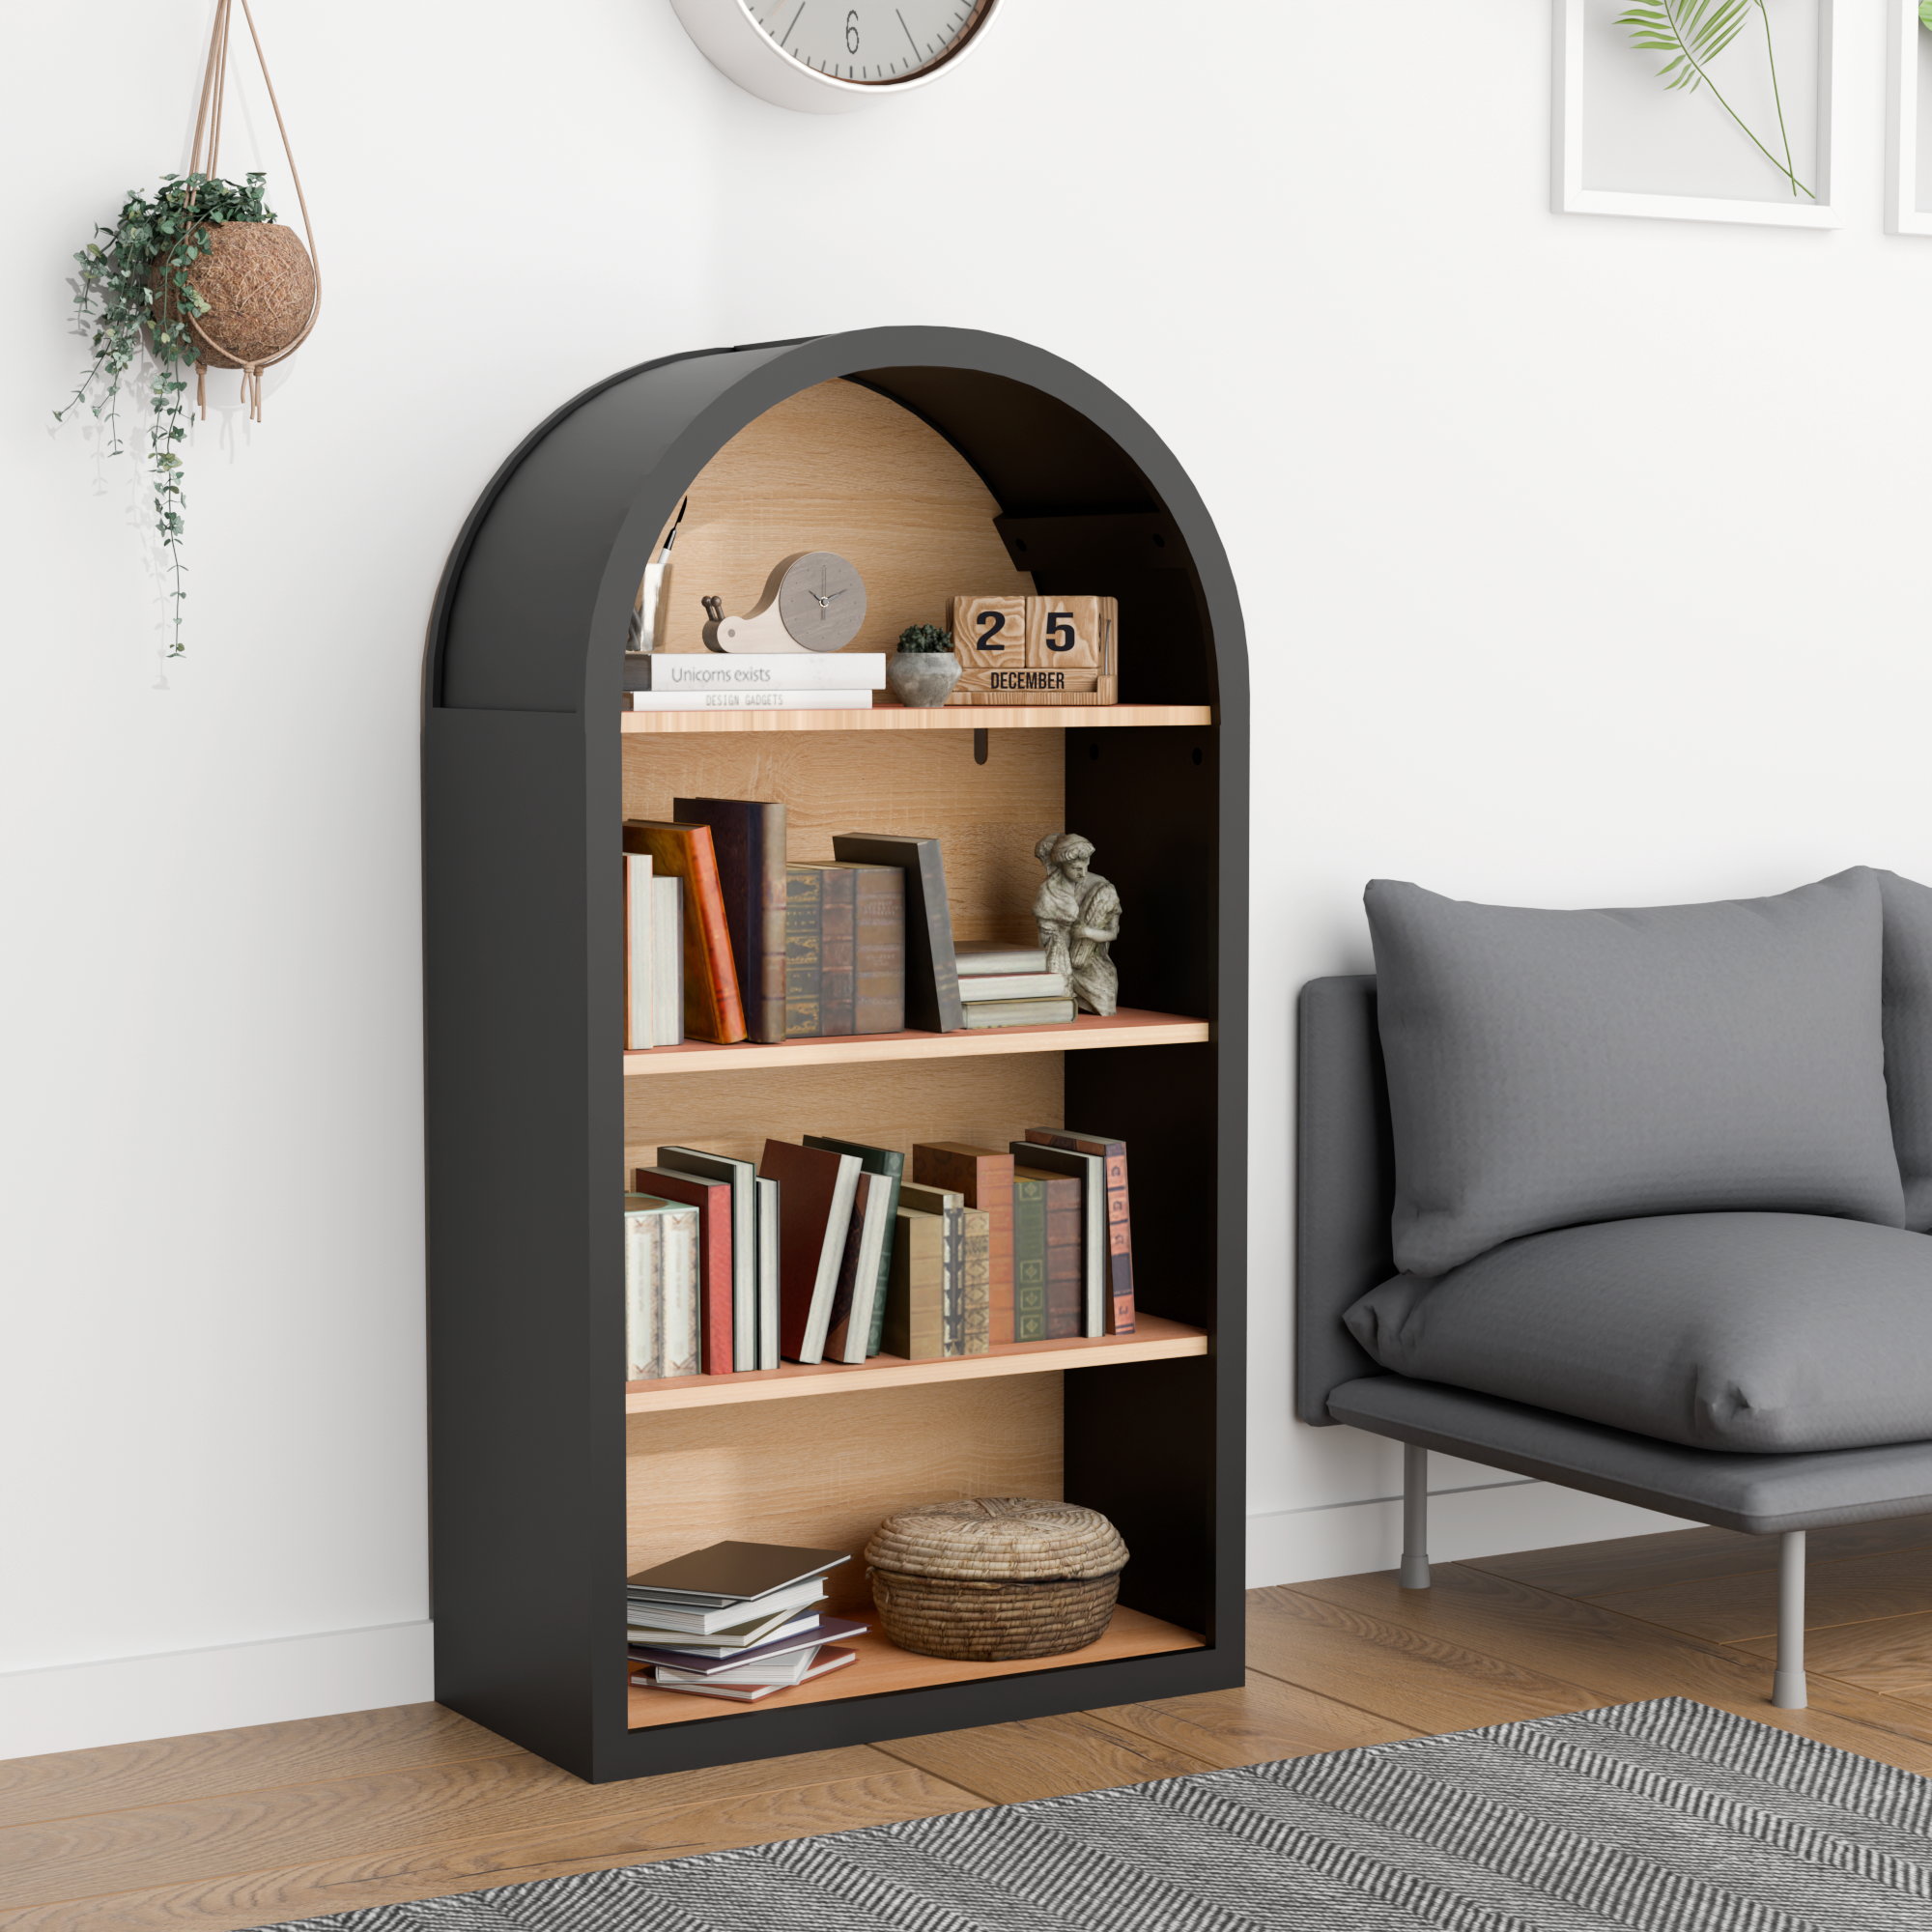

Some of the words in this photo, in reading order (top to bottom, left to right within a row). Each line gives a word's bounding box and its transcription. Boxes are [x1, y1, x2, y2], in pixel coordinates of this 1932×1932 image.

[846, 10, 859, 55] 6
[671, 667, 731, 683] Unicorns
[734, 667, 771, 682] exists
[990, 671, 1065, 690] DECEMBER
[706, 695, 739, 706] DESIGN
[745, 694, 783, 706] GADGETS
